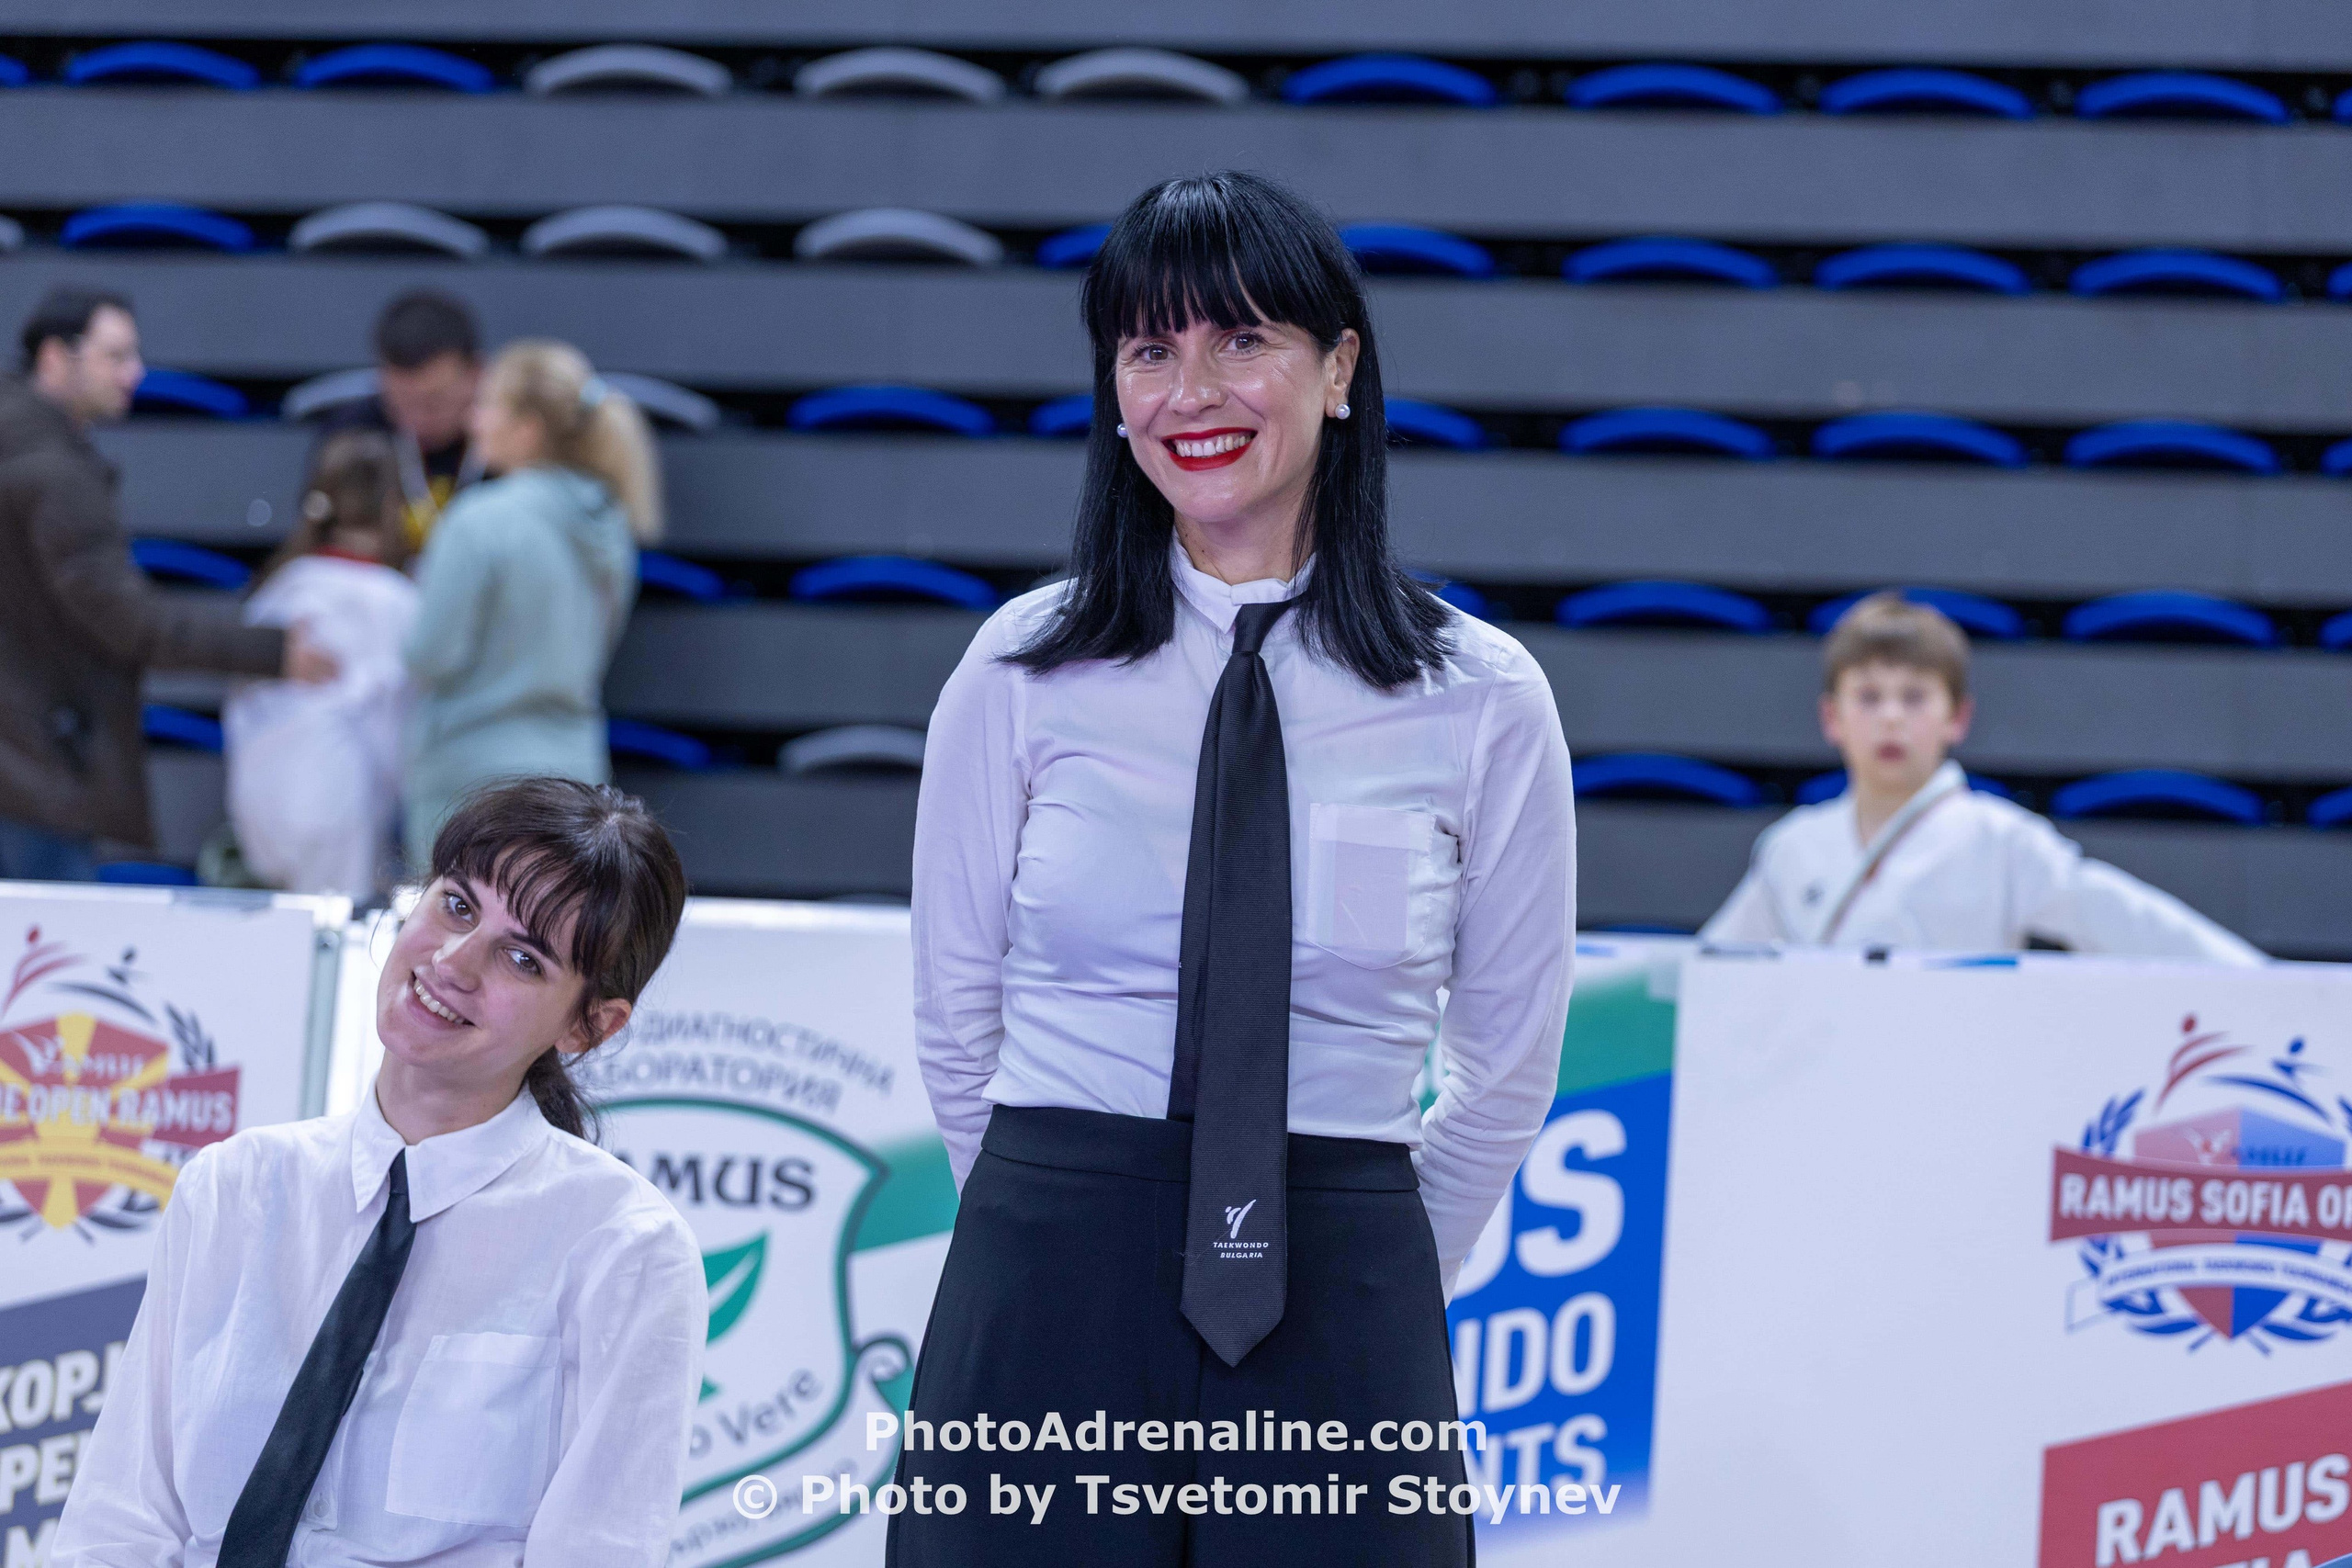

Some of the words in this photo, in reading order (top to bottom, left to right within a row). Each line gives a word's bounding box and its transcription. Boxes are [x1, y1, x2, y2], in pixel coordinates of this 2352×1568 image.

[28, 1082, 112, 1126] OPEN
[116, 1087, 236, 1134] RAMUS
[2058, 1172, 2196, 1224] RAMUS
[2199, 1179, 2311, 1229] SOFIA
[2096, 1452, 2351, 1568] RAMUS
